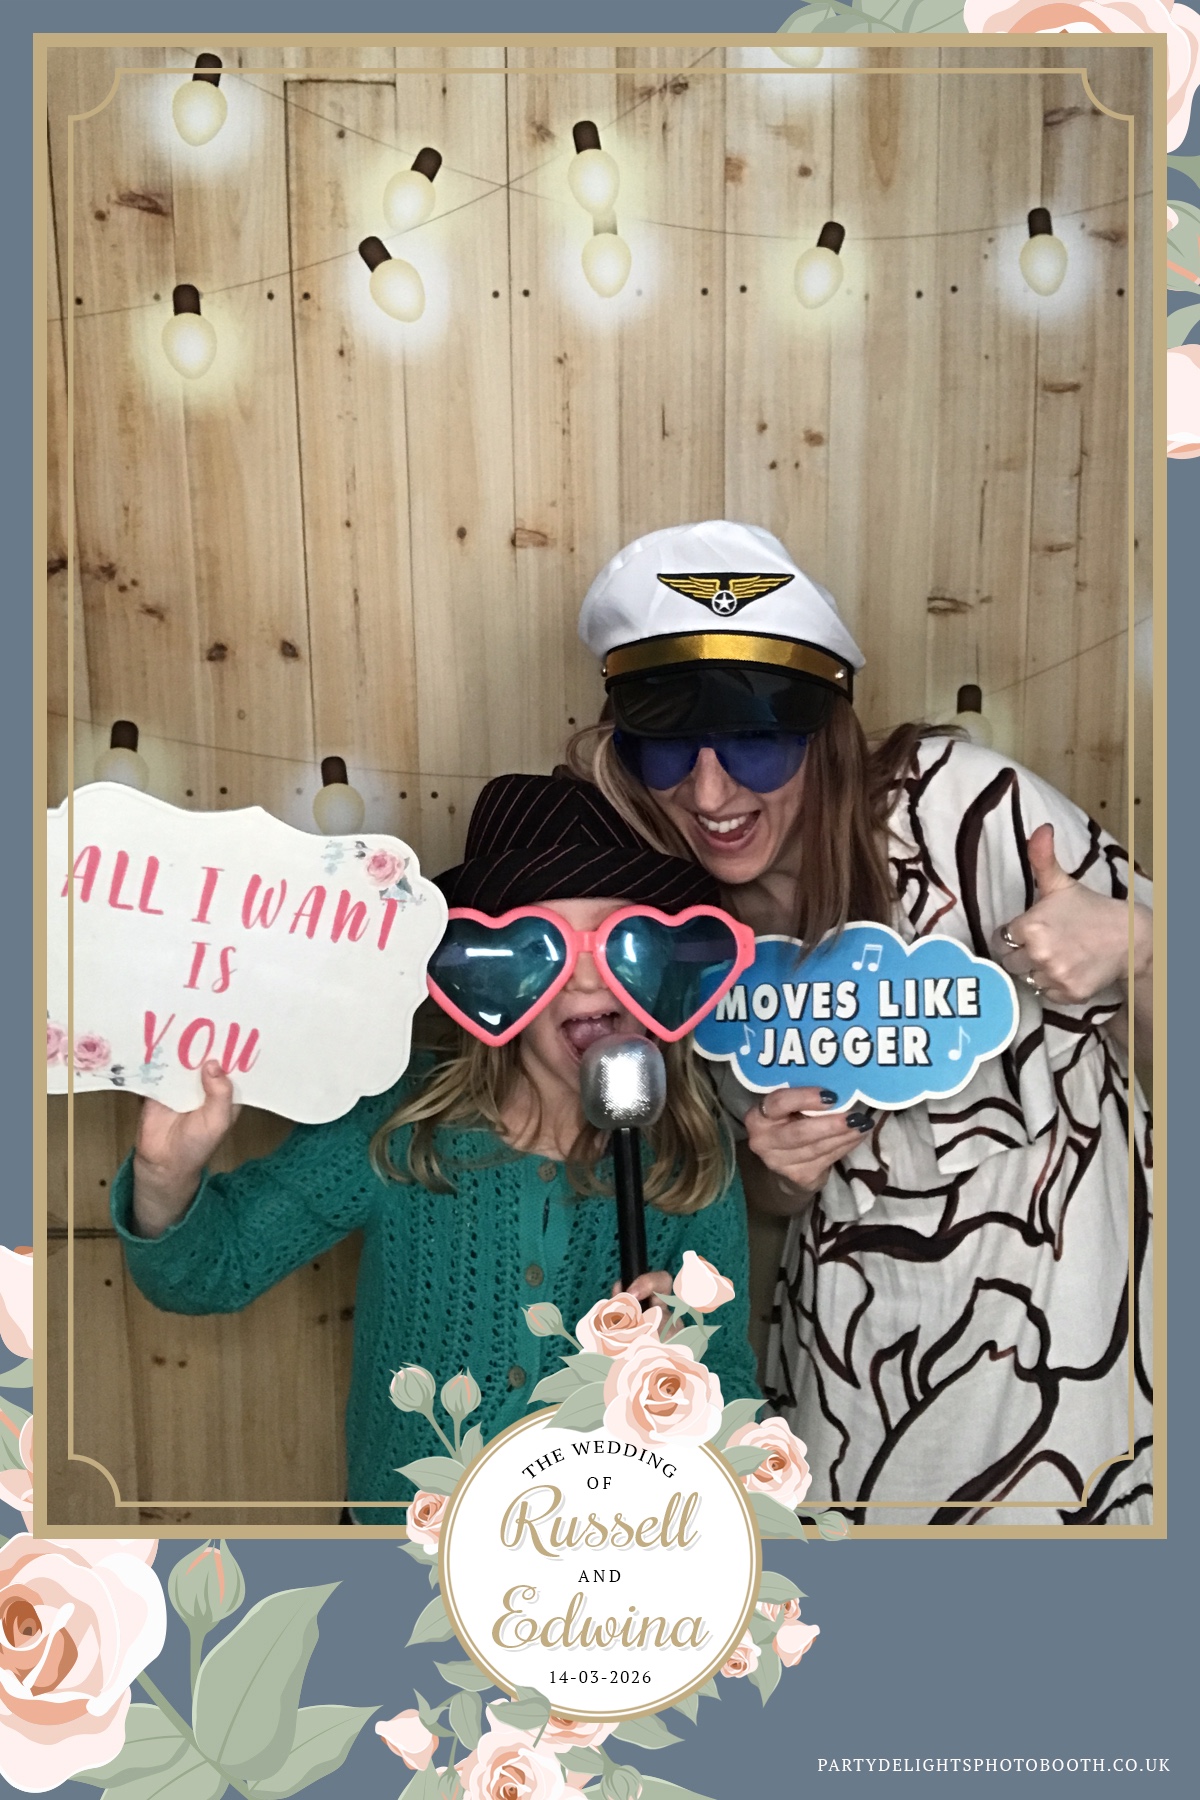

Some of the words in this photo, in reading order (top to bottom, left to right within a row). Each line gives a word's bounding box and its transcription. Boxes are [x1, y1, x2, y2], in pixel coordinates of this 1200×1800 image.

[61, 845, 163, 916] ALL
[191, 866, 224, 925] I
[183, 941, 237, 993] IS
[715, 981, 859, 1022] MOVES
[878, 977, 981, 1019] LIKE
[757, 1026, 932, 1066] JAGGER
